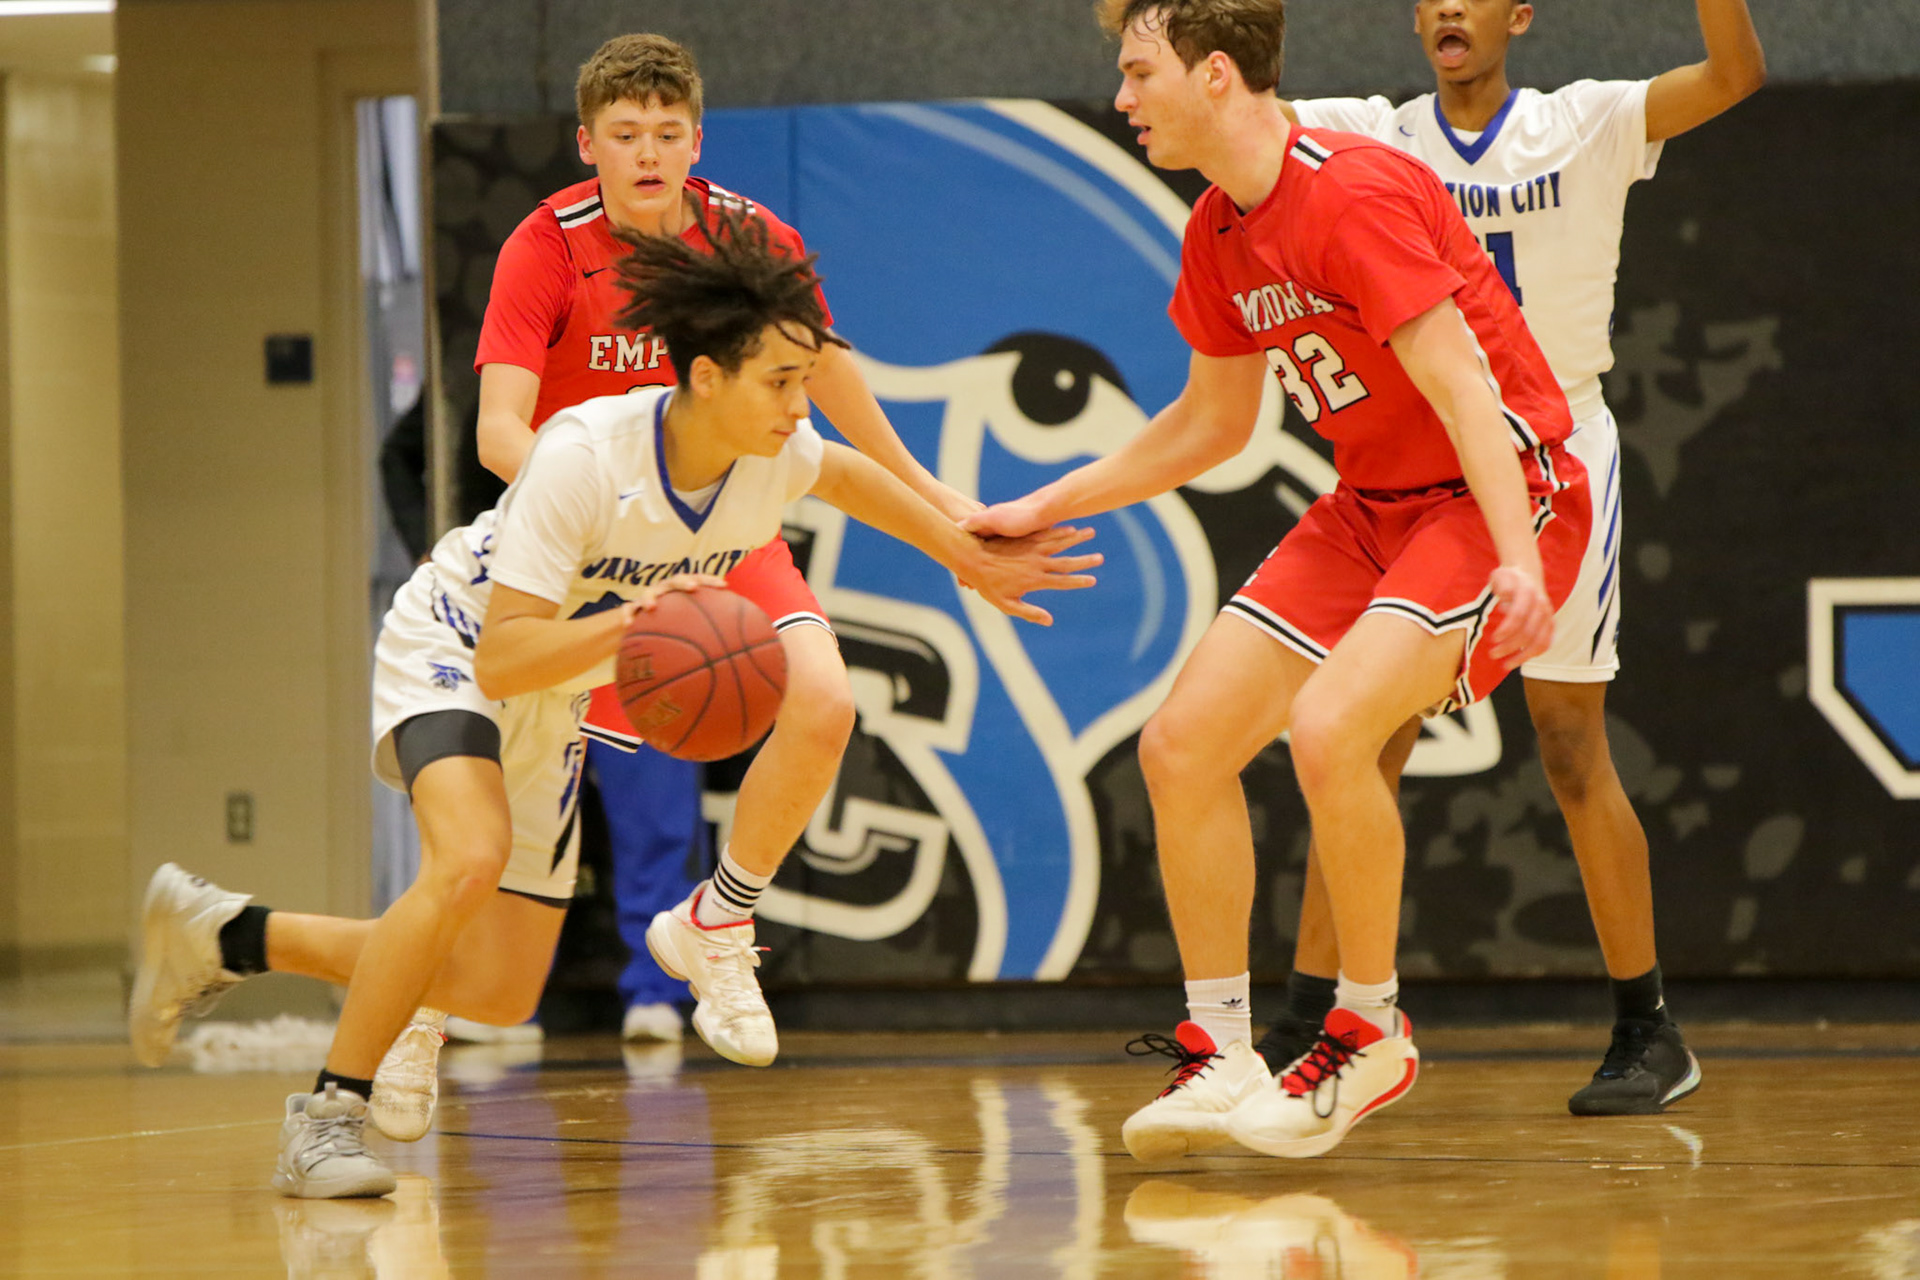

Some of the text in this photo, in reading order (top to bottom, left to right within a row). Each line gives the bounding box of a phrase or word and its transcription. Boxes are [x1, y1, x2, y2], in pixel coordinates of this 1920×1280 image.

[1511, 171, 1561, 214] CITY
[1474, 231, 1523, 307] 1
[1265, 330, 1371, 424] 32
